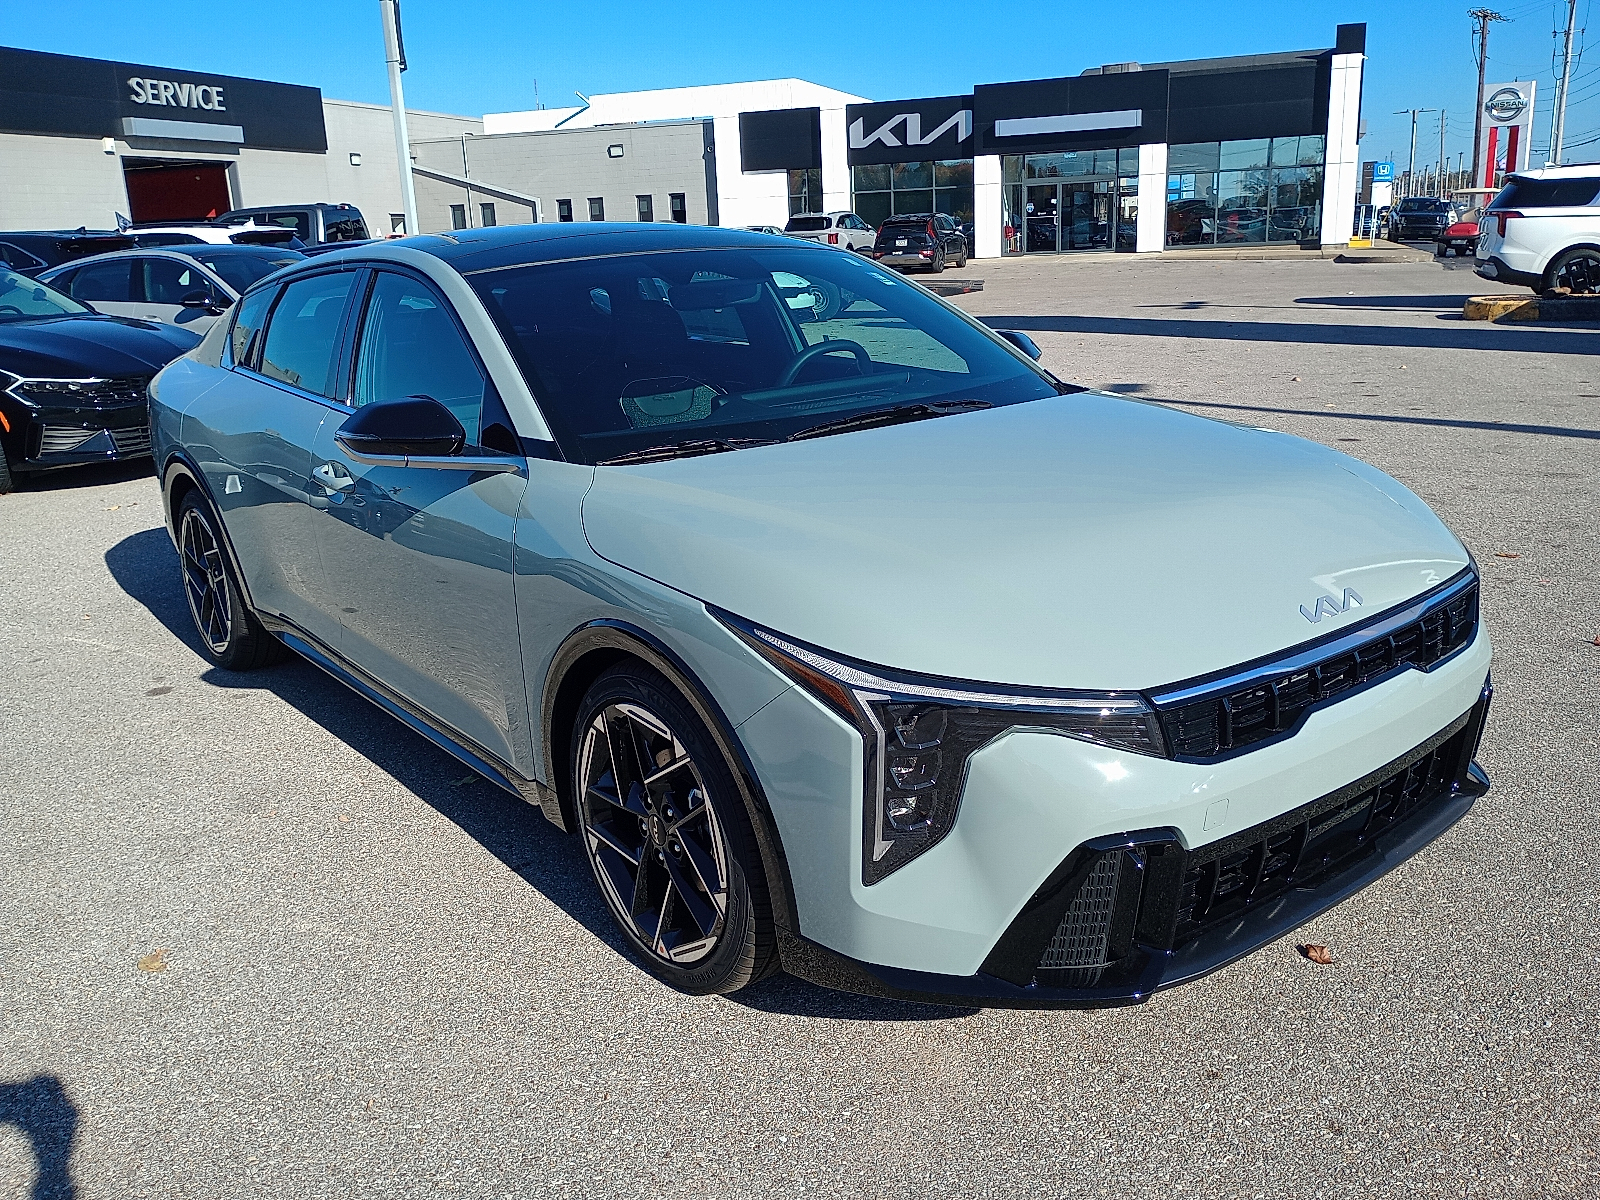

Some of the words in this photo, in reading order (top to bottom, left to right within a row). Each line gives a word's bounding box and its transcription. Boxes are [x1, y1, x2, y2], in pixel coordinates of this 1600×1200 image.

[127, 77, 227, 111] SERVICE
[1490, 100, 1524, 108] NISSAN
[849, 109, 973, 149] KIA
[1299, 587, 1363, 624] KIA
